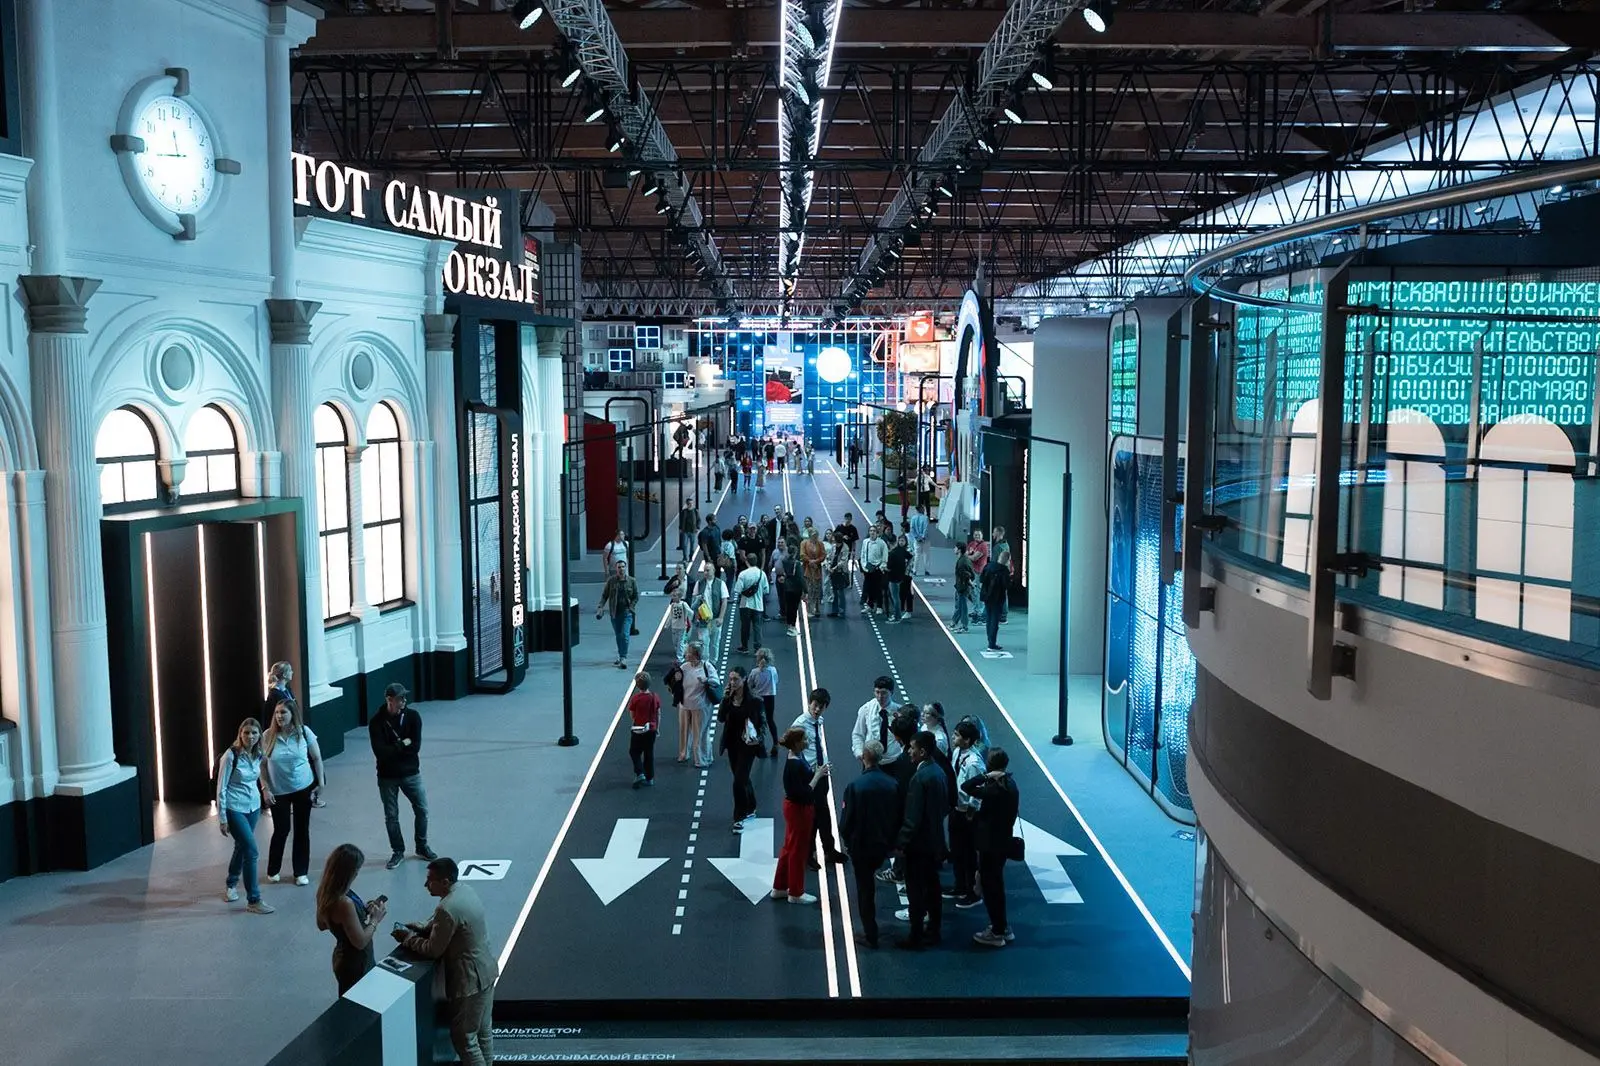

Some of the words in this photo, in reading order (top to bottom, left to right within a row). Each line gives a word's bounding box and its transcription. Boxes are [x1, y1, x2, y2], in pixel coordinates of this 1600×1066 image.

[158, 107, 166, 121] 11
[171, 106, 181, 120] 12
[385, 179, 503, 249] САМЫЙ
[441, 250, 535, 304] ОКЗАЛ
[511, 433, 519, 487] ВОКЗАЛ
[511, 489, 521, 603] ЛЕНИНГРАДСКИЙ
[530, 1053, 631, 1061] УКАТЫВАЕМЫЙ
[633, 1053, 677, 1061] БЕТОН
